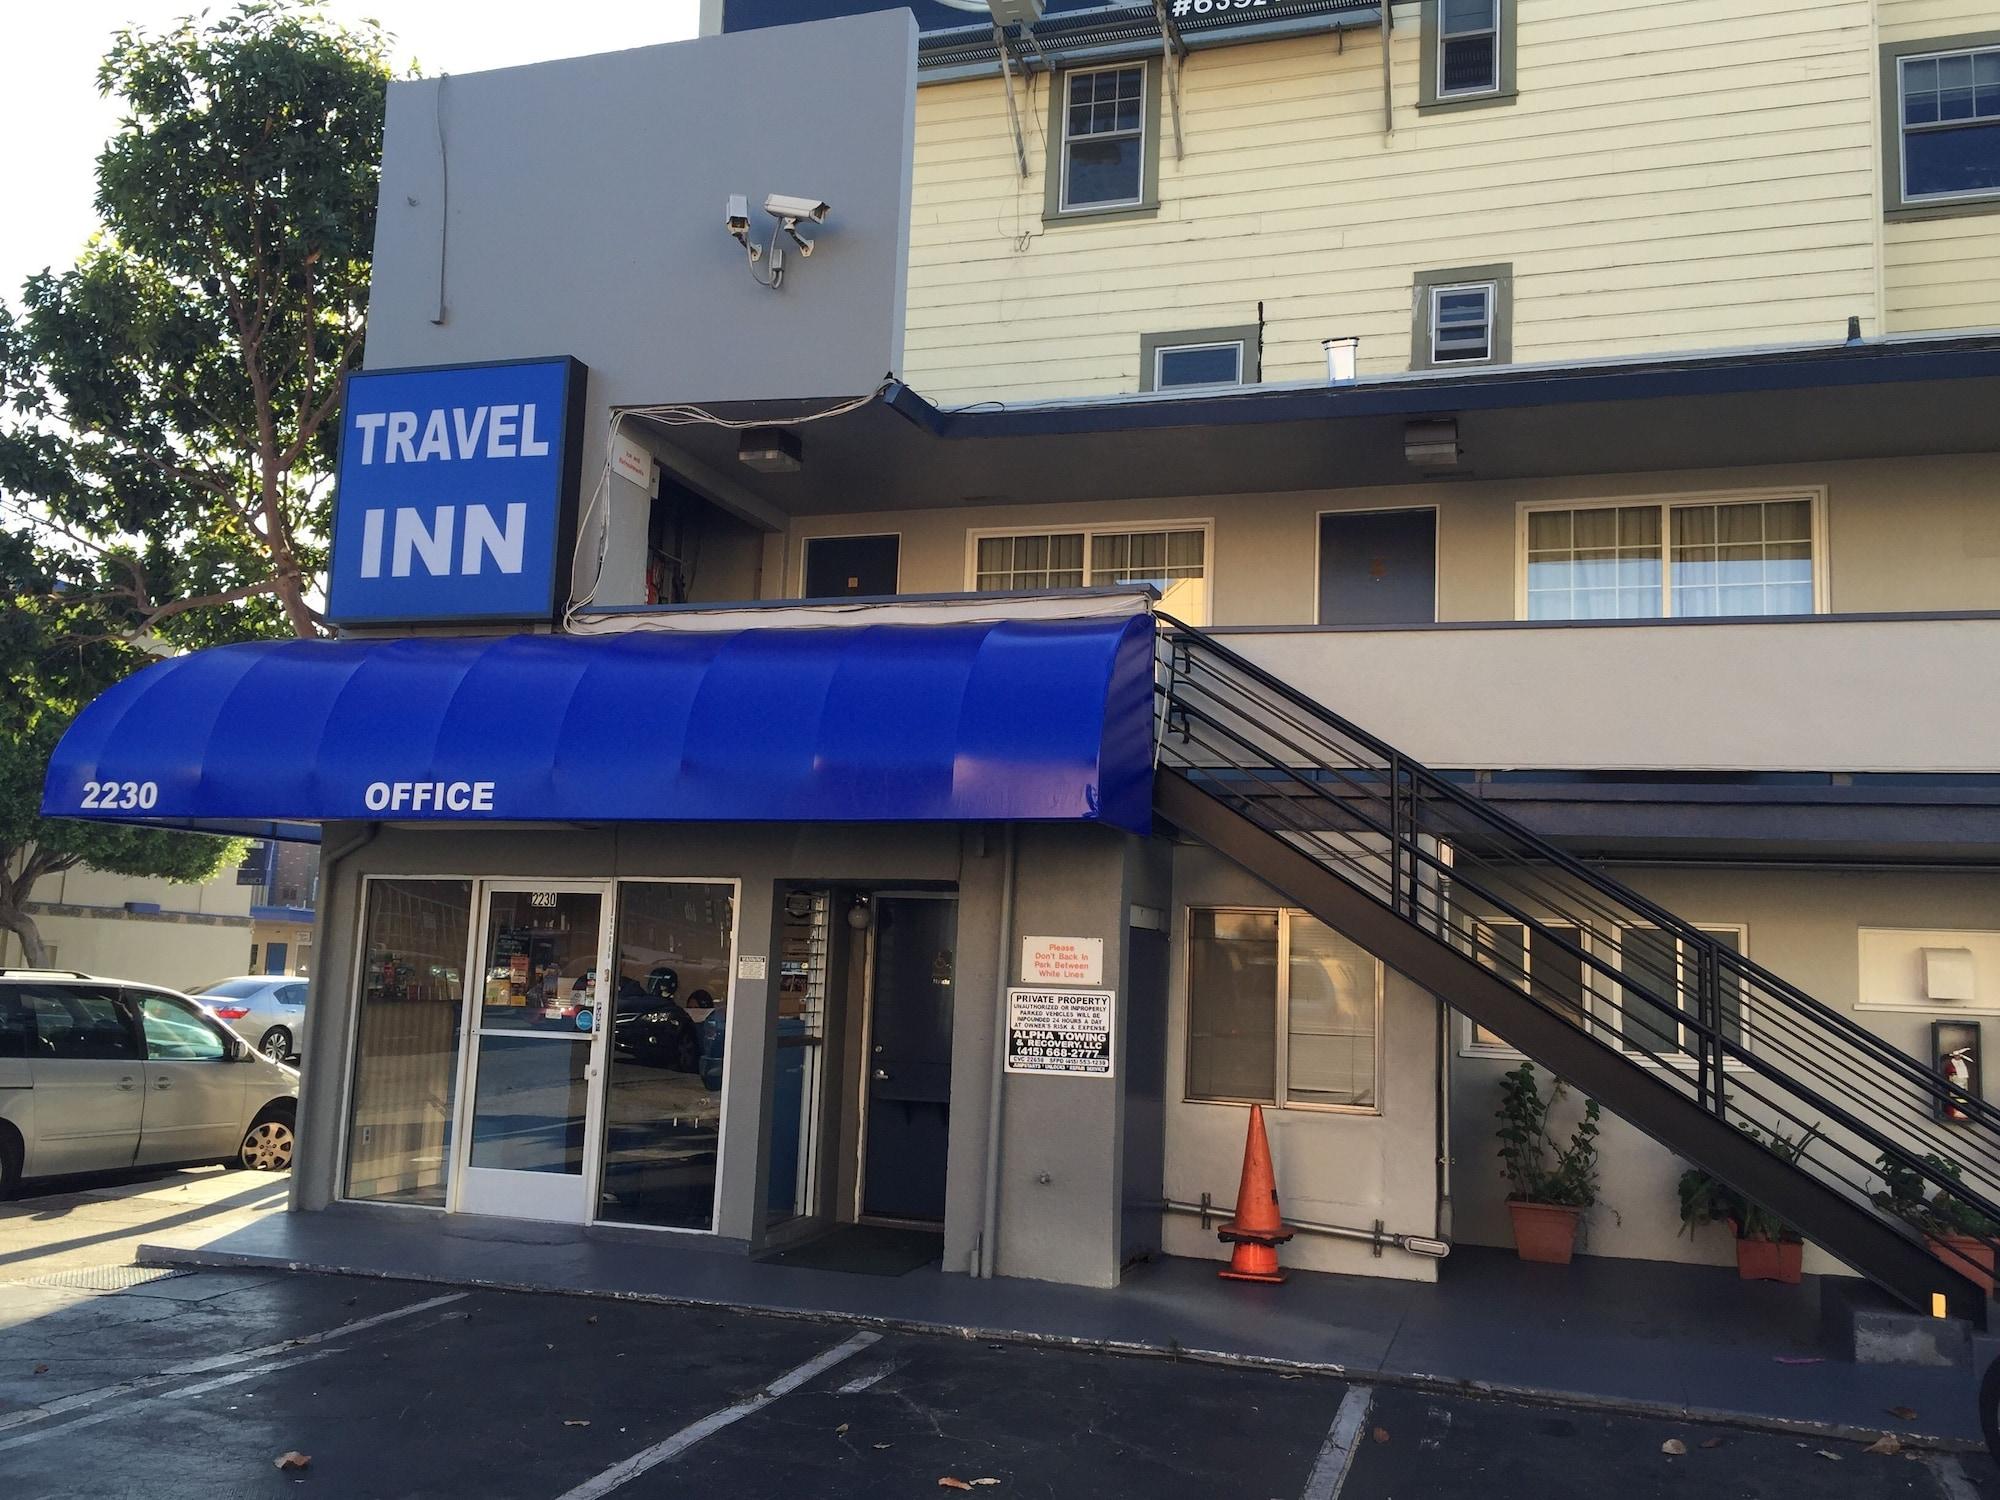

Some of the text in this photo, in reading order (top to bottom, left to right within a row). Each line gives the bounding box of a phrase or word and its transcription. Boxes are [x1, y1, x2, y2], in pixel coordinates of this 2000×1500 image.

[356, 404, 549, 465] TRAVEL
[361, 503, 527, 578] INN
[80, 782, 158, 809] 2230
[365, 782, 495, 810] OFFICE
[532, 893, 557, 906] 2230
[1017, 995, 1108, 1005] PRIVATE PROPERTY
[1013, 1031, 1106, 1042] ALPHA TOWING
[1017, 1047, 1043, 1055] (415)
[1046, 1049, 1099, 1058] 668-2777
